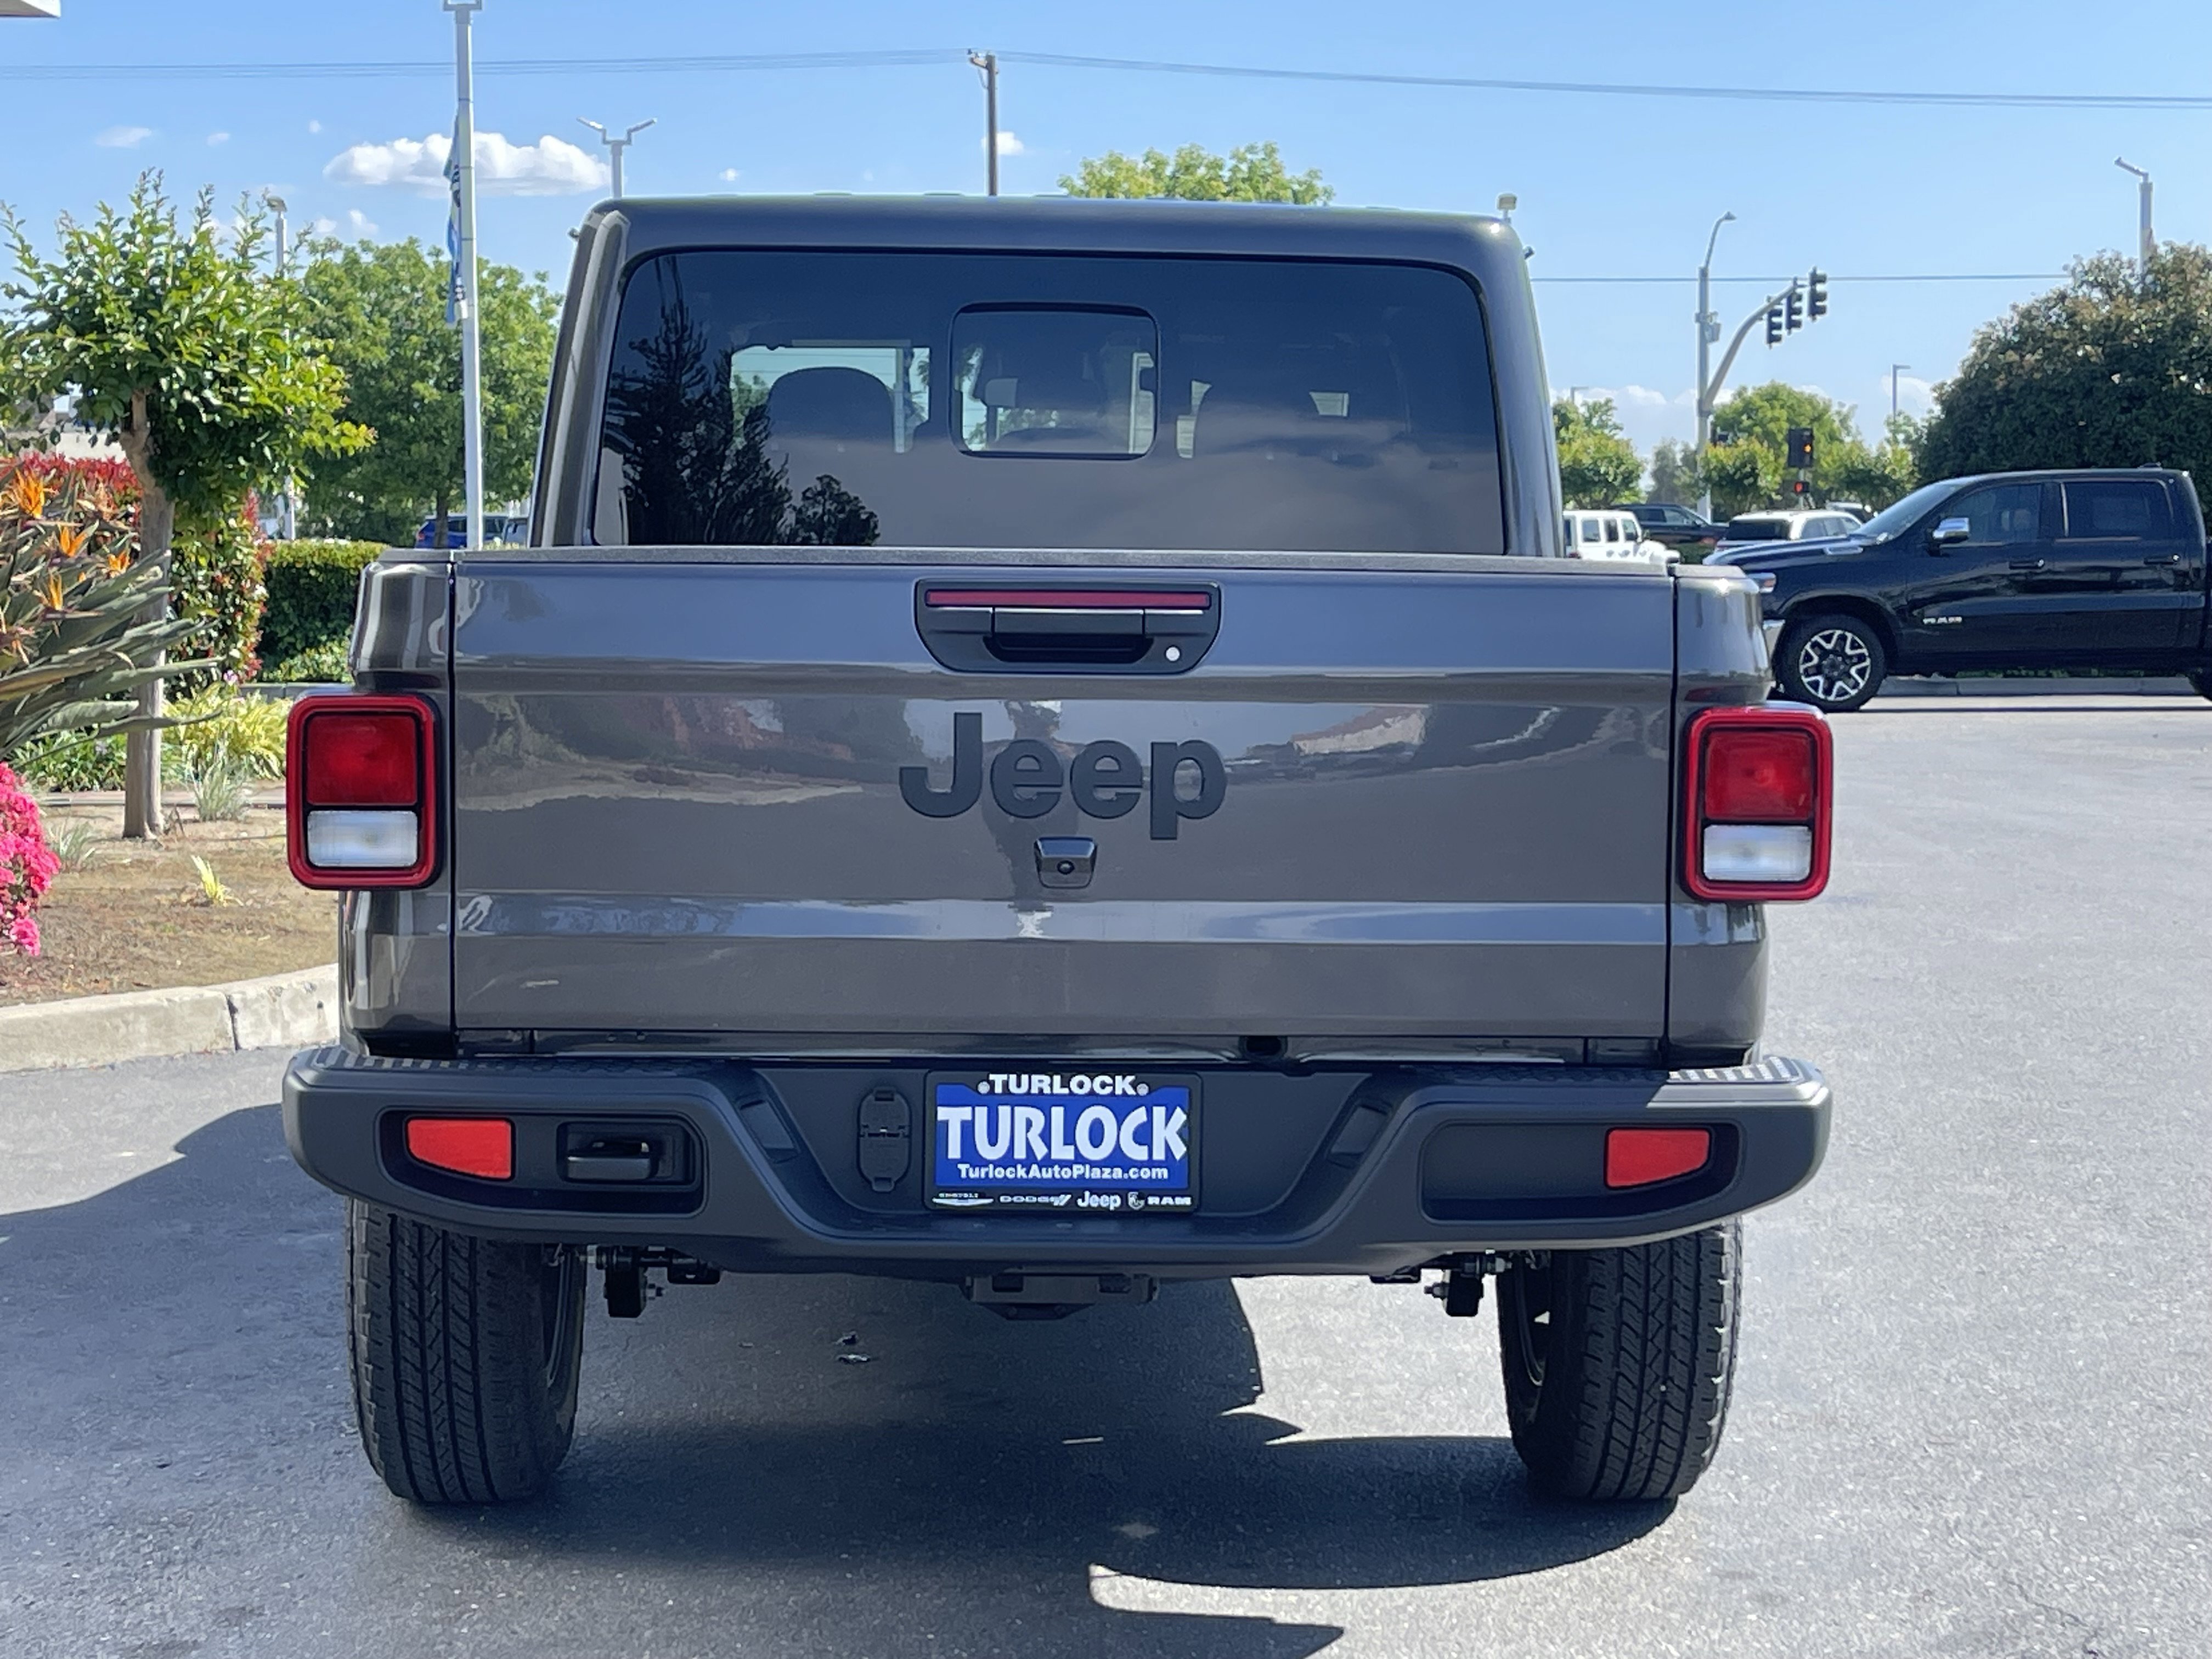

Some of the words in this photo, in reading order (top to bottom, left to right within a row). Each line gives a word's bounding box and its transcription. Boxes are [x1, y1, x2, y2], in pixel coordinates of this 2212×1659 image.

[899, 712, 1227, 840] Jeep
[989, 1074, 1136, 1095] TURLOCK
[937, 1105, 1187, 1161] TURLOCK
[957, 1164, 1169, 1180] TurlockAutoPlaza.com
[1077, 1190, 1121, 1210] Jeep
[1147, 1195, 1192, 1205] RAM
